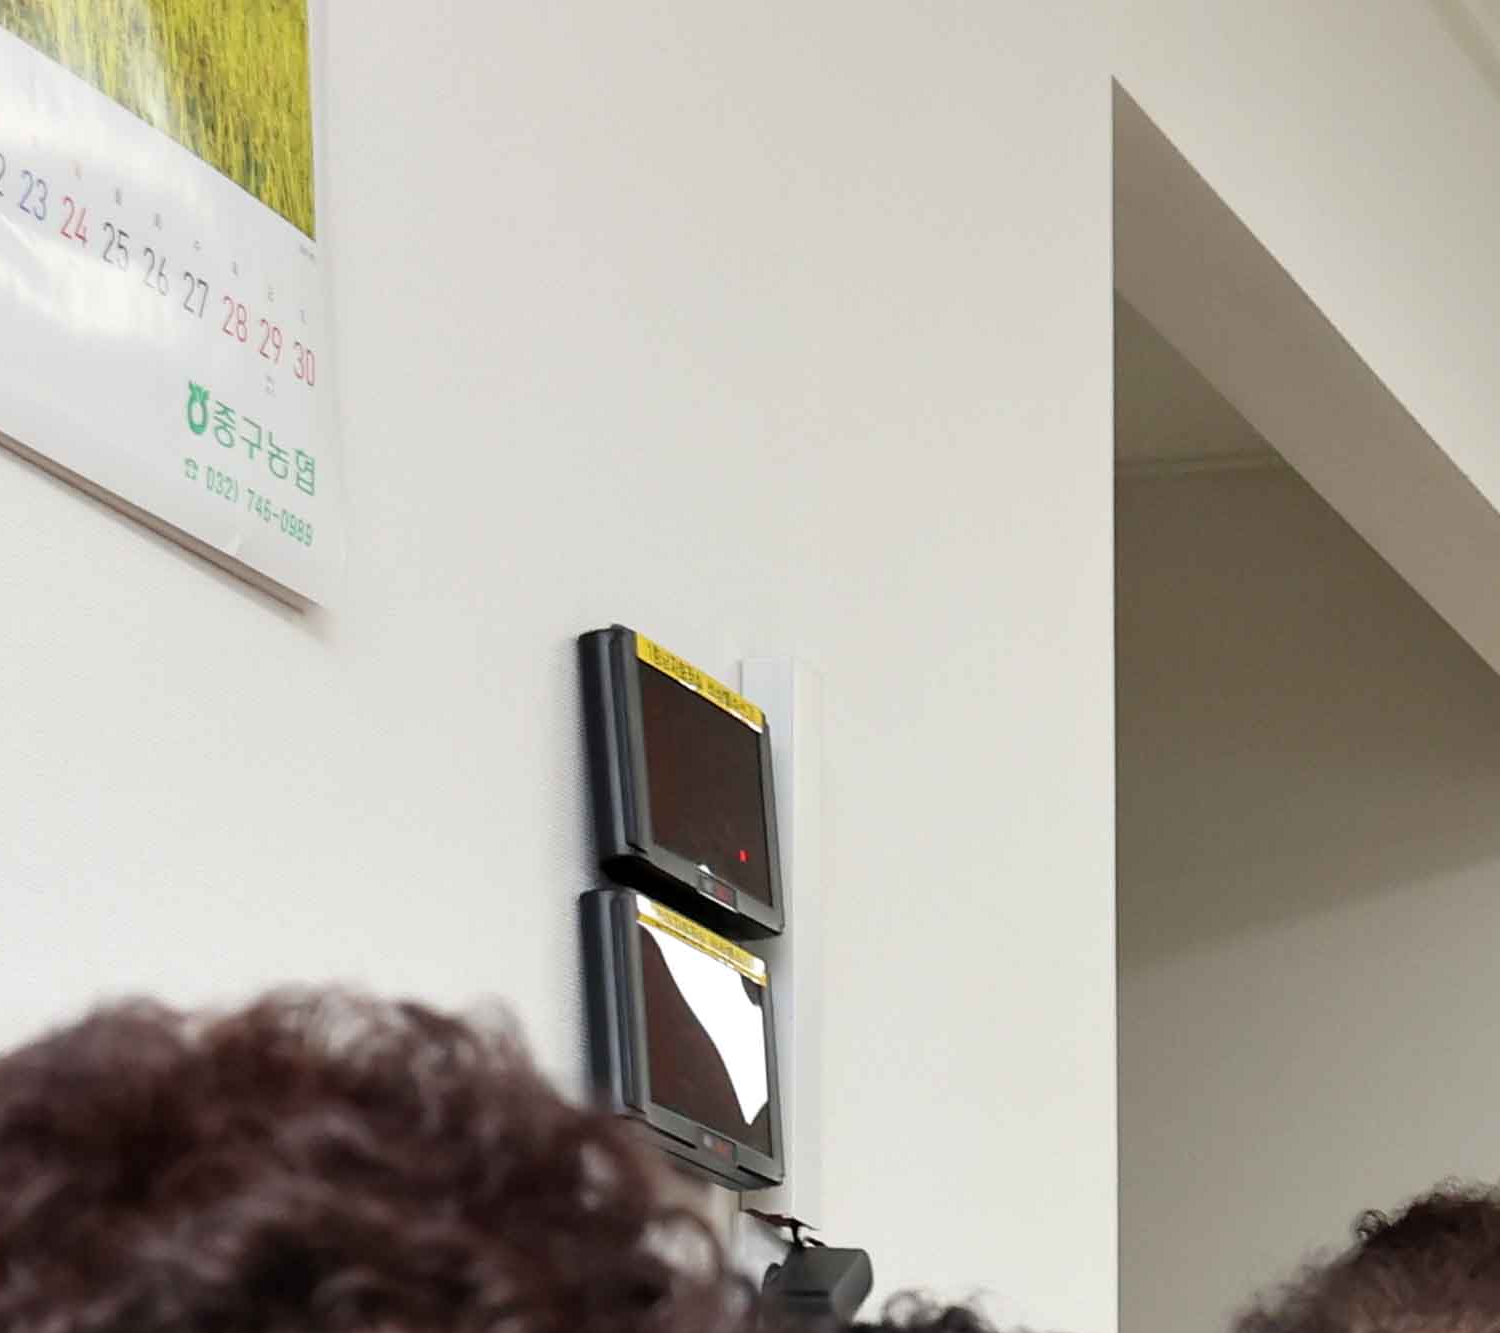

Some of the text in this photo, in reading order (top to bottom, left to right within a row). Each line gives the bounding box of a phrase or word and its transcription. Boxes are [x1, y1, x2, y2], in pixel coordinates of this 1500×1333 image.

[19, 170, 49, 221] 23
[60, 196, 88, 248] 24
[103, 221, 131, 273] 25
[143, 247, 169, 297] 26
[183, 271, 210, 319] 27
[222, 296, 248, 343] 28
[260, 318, 284, 365] 29
[293, 341, 316, 387] 30
[212, 400, 315, 497] 중구농협
